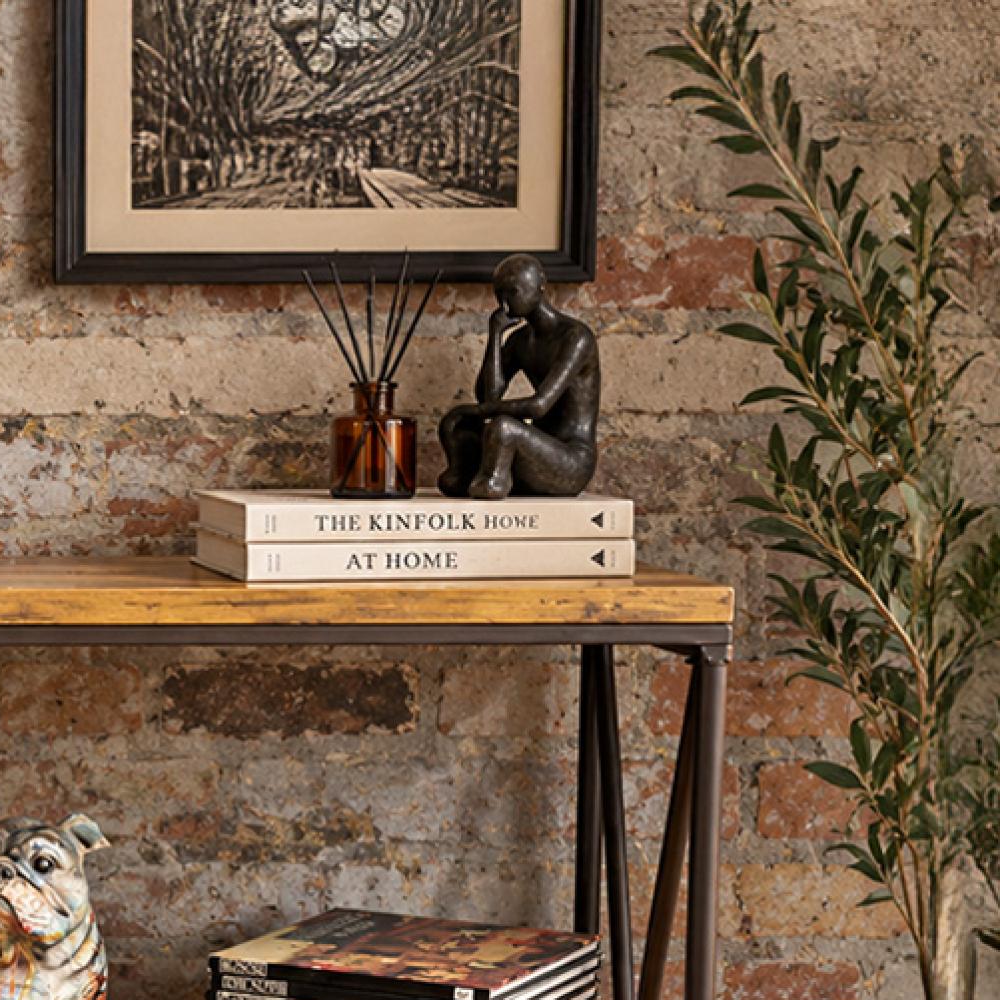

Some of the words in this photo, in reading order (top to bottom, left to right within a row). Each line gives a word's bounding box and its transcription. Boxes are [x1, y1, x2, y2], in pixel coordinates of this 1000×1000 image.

[314, 514, 361, 532] THE
[368, 513, 476, 531] KINFOLK
[346, 552, 378, 570] AT
[384, 552, 459, 569] HOME
